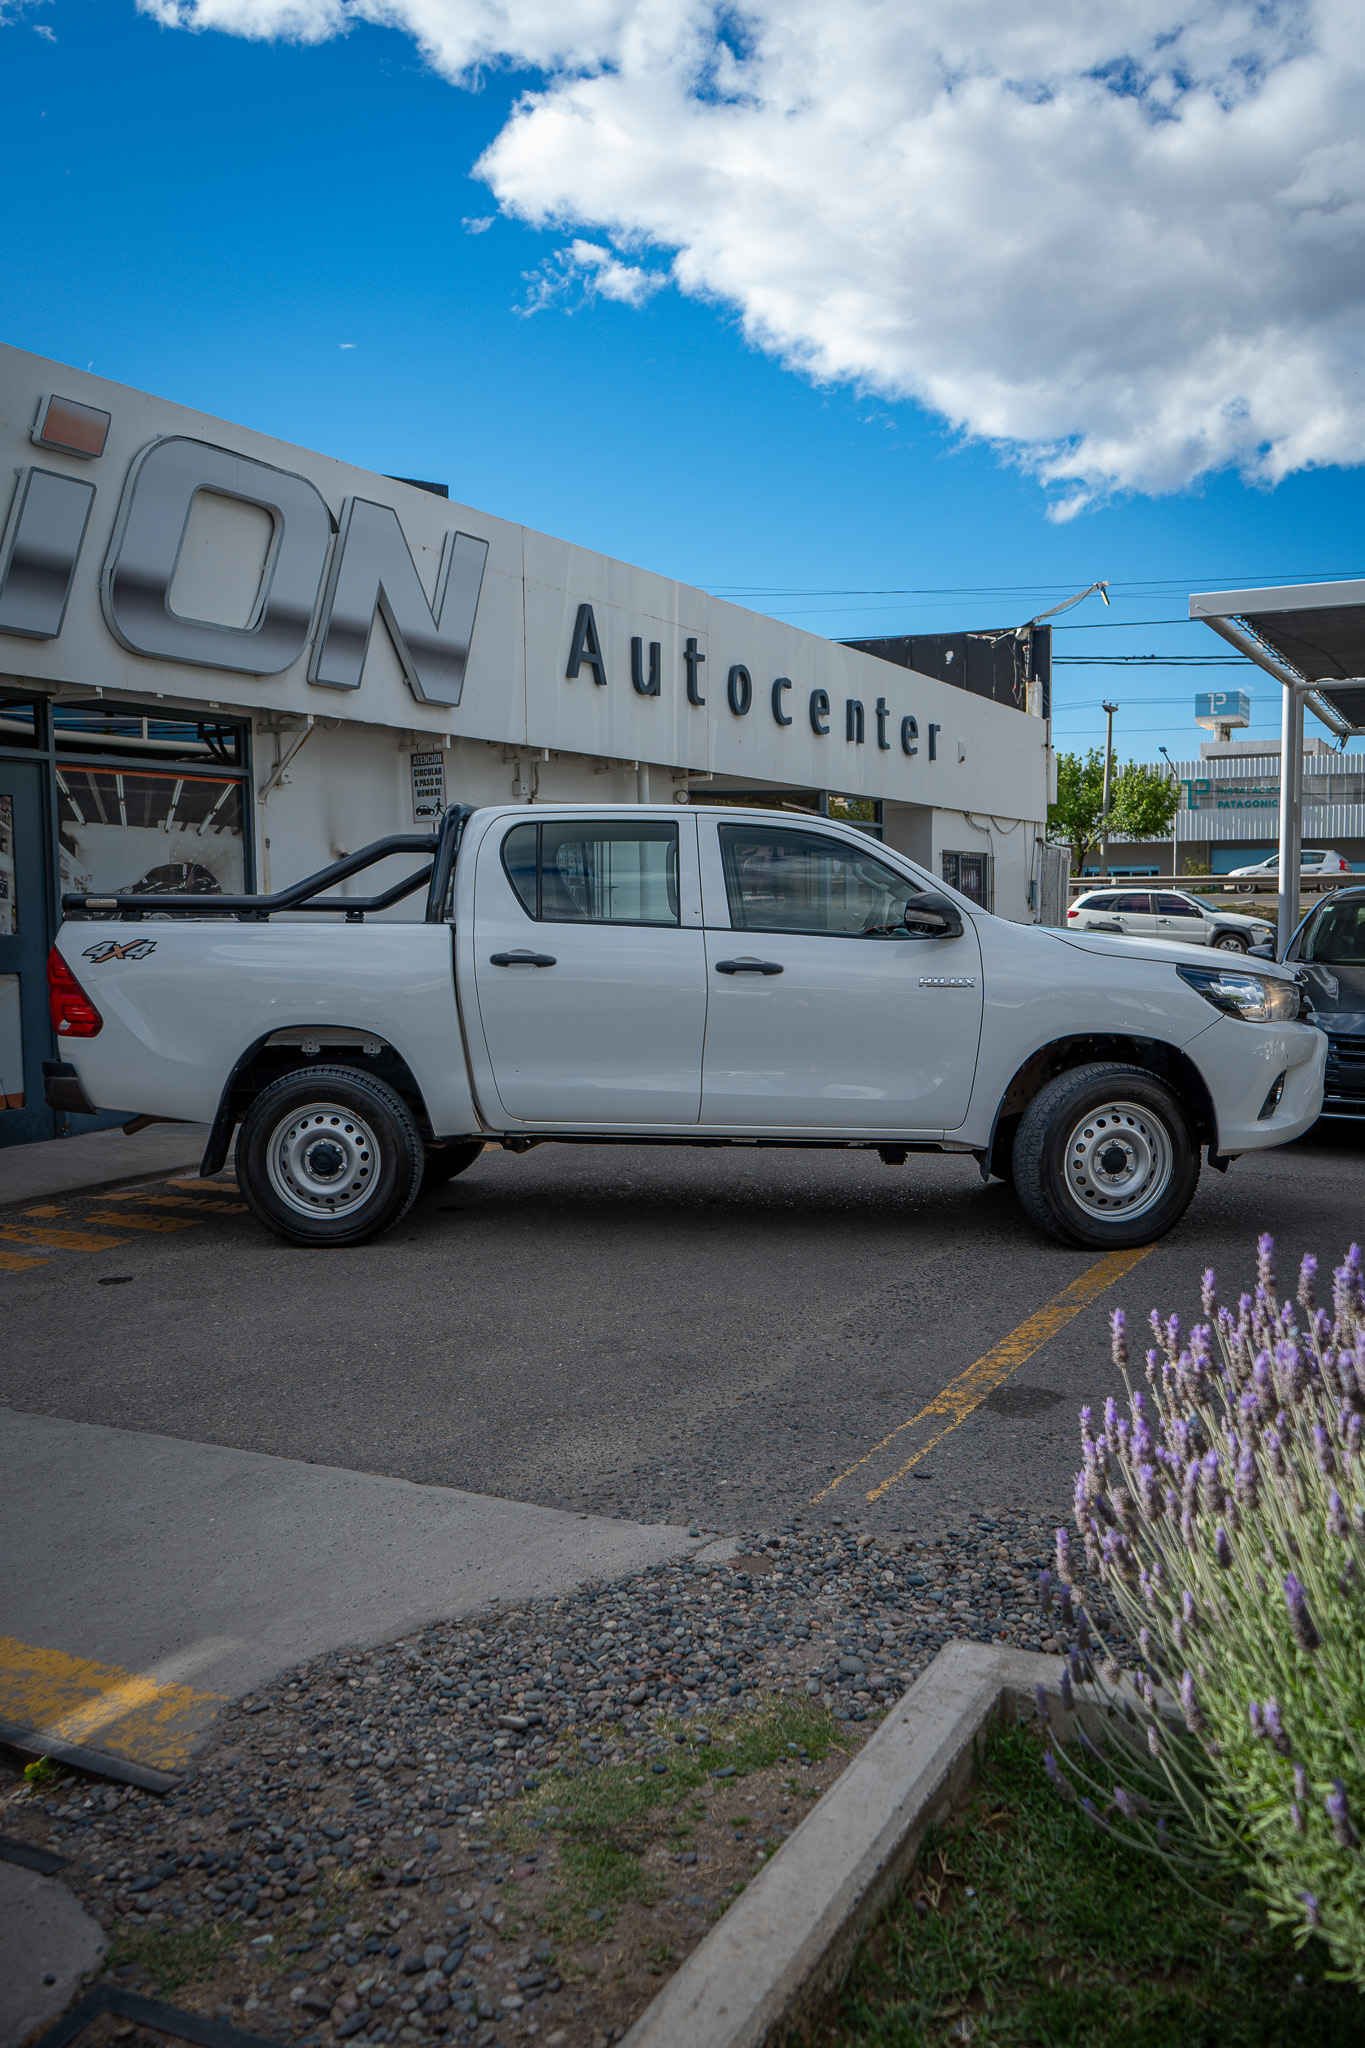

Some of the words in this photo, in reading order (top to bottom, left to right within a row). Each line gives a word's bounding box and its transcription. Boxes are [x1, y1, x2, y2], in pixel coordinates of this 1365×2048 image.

[566, 603, 941, 764] Autocenter
[413, 753, 442, 765] ATENCION
[413, 767, 442, 777] CIRCULAR
[420, 779, 434, 787] PASO
[417, 788, 441, 797] HOMBRE
[919, 977, 976, 987] HILUX
